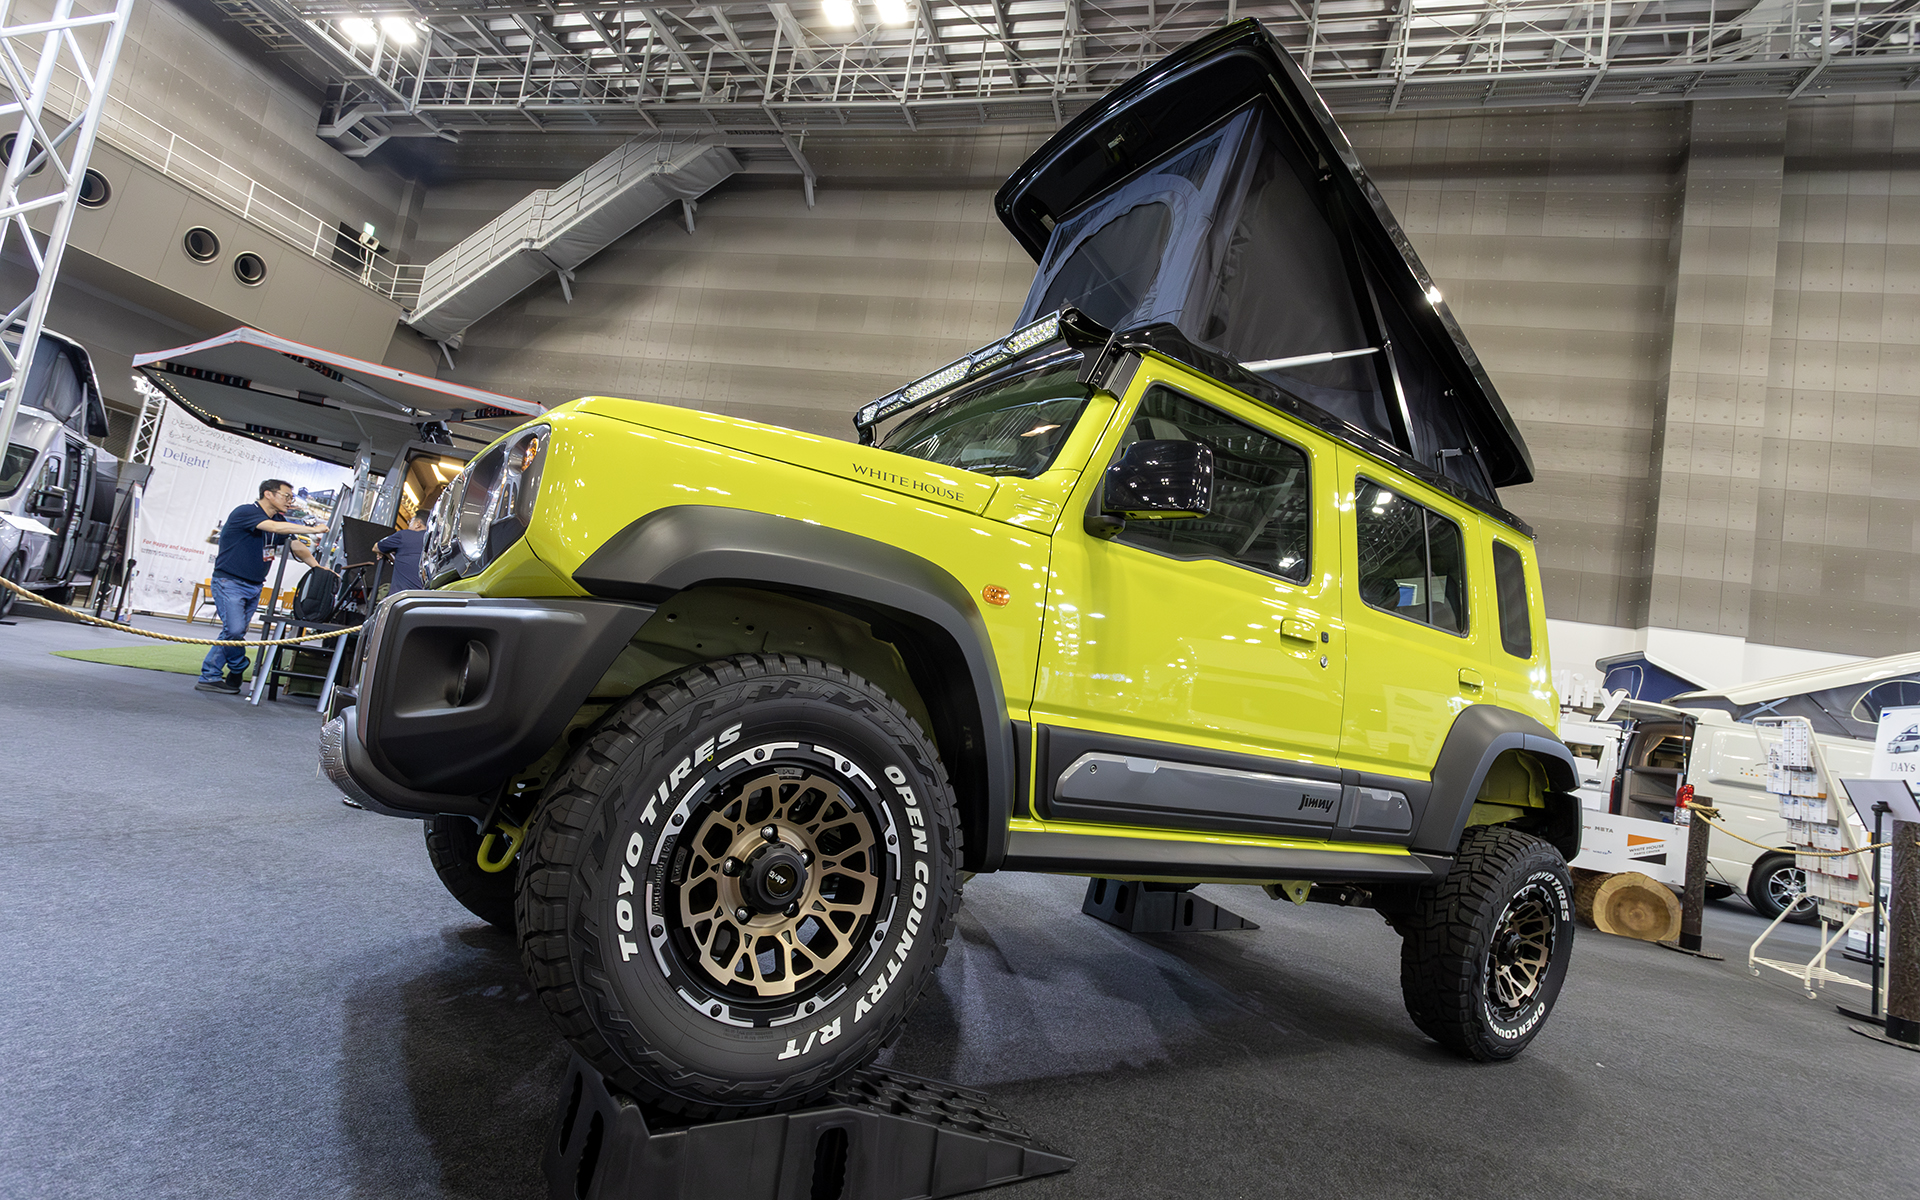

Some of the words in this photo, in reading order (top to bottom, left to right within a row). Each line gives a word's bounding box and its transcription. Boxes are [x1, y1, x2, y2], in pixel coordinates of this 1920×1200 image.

[163, 447, 210, 469] Delight!
[852, 463, 910, 488] WHITE
[913, 480, 965, 503] HOUSE
[152, 540, 168, 549] Happy
[179, 545, 205, 555] Happiness
[884, 765, 929, 854] OPEN
[1297, 793, 1334, 813] Jimny
[616, 831, 644, 962] TOYO
[639, 721, 743, 826] TIRES
[1525, 871, 1556, 885] TOYO
[1551, 877, 1570, 922] TIRES
[853, 860, 929, 1024] COUNTRY
[777, 1016, 842, 1061] R/T
[1518, 1001, 1546, 1036] OPEN
